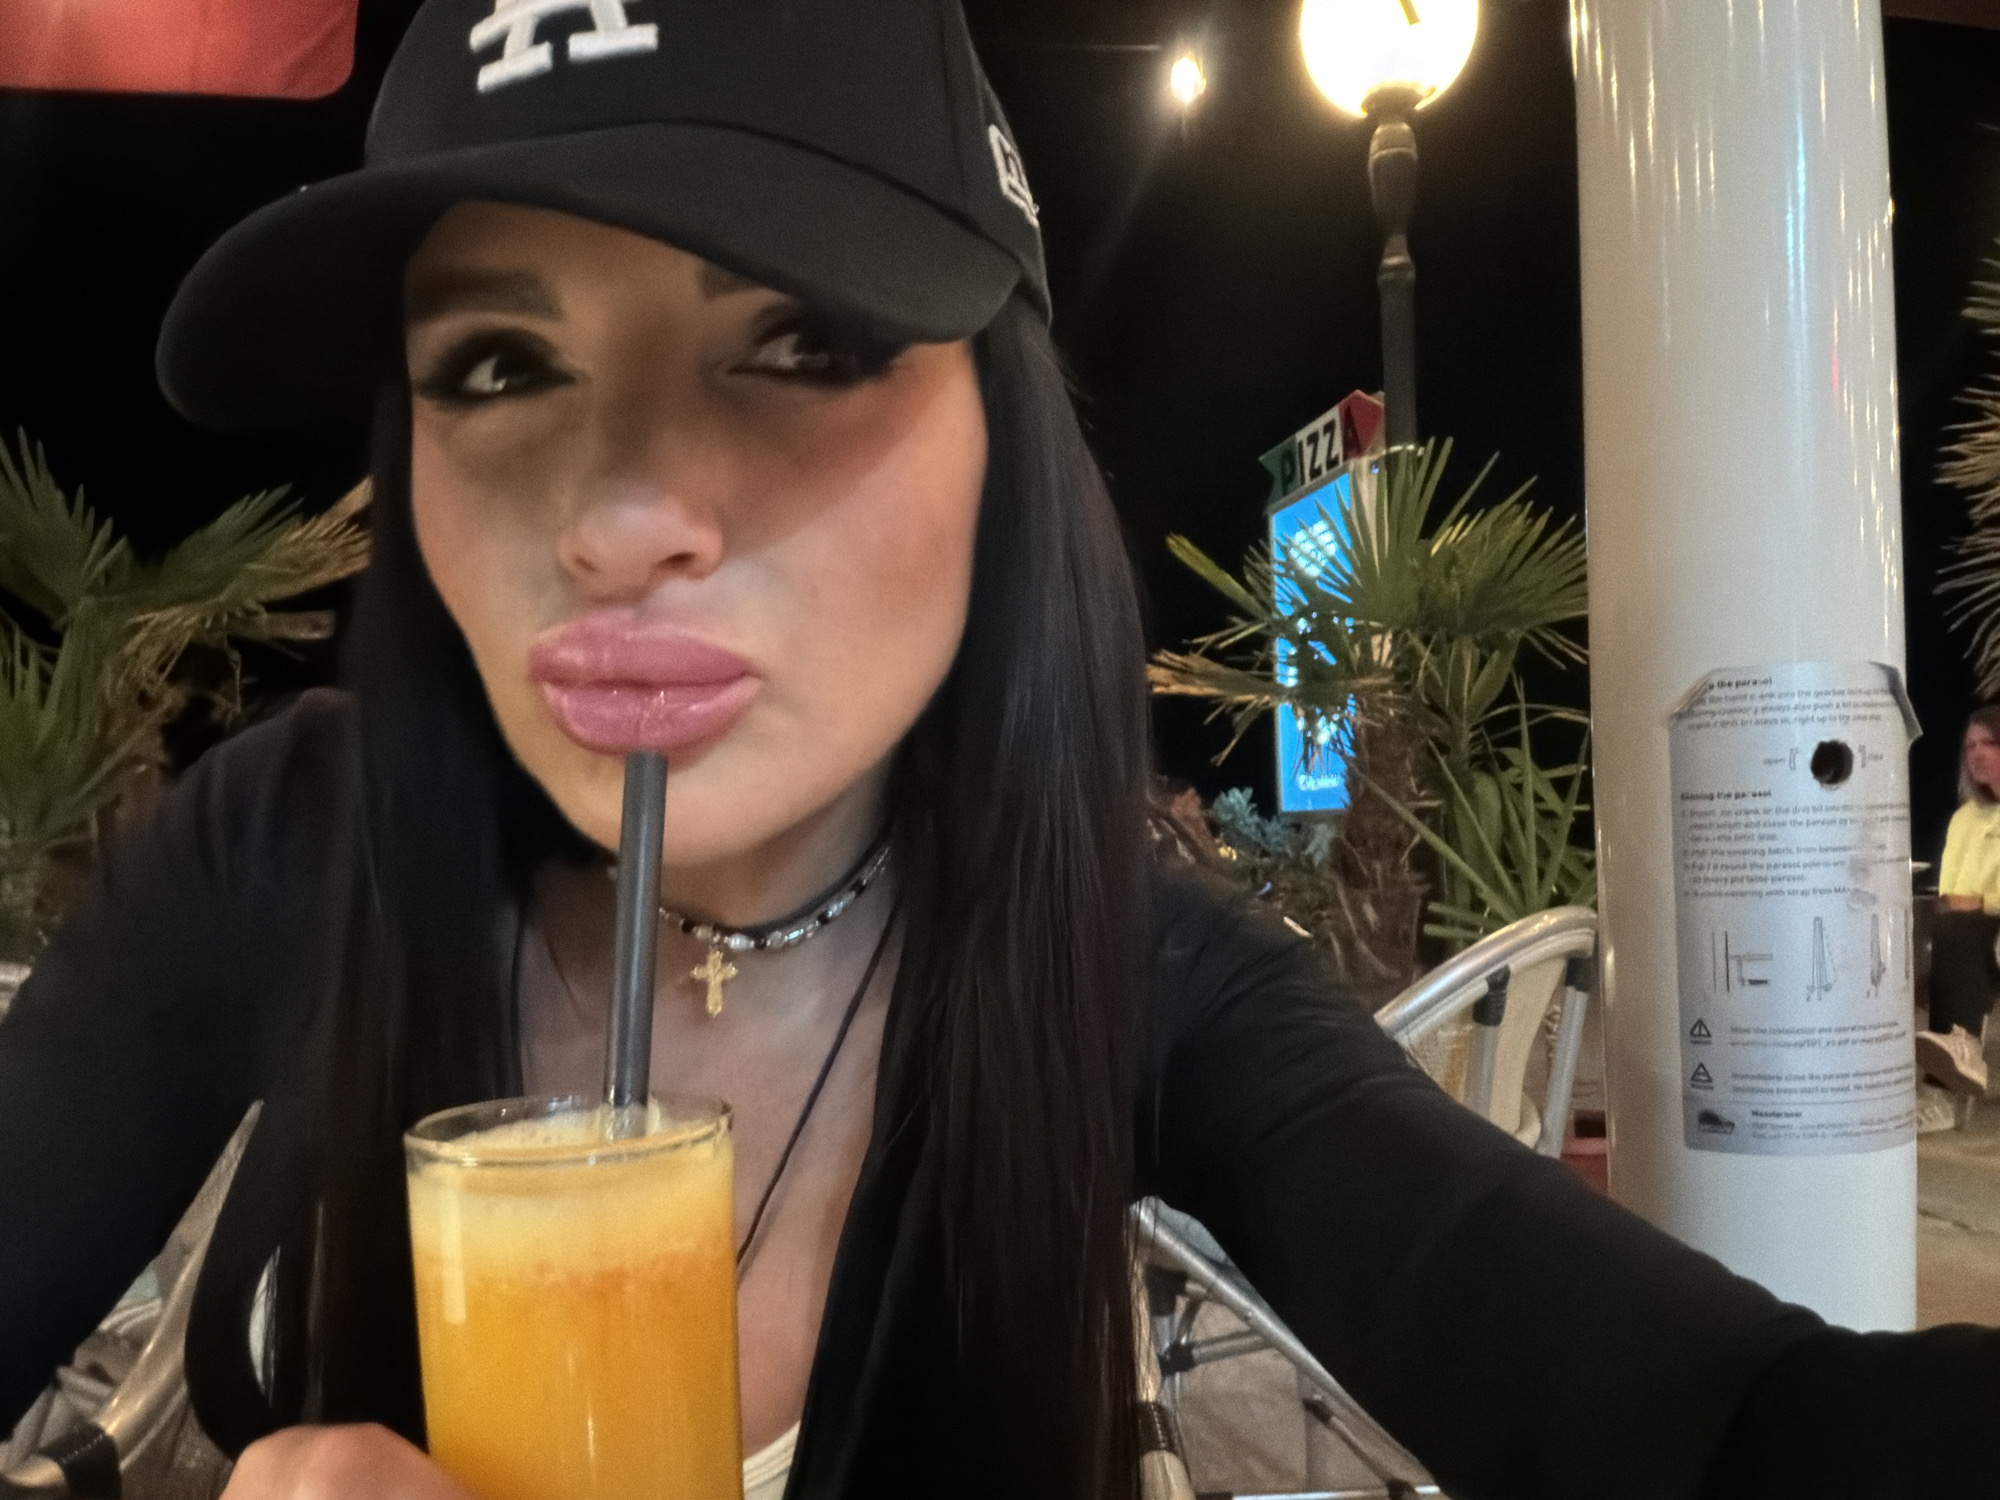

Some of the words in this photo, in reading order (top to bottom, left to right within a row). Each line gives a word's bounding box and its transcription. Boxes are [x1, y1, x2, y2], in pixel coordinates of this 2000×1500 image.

[1281, 404, 1362, 496] PIZZA
[1717, 679, 1732, 688] the
[1735, 676, 1772, 689] parasol
[1717, 791, 1732, 799] the
[1735, 789, 1772, 800] parasol
